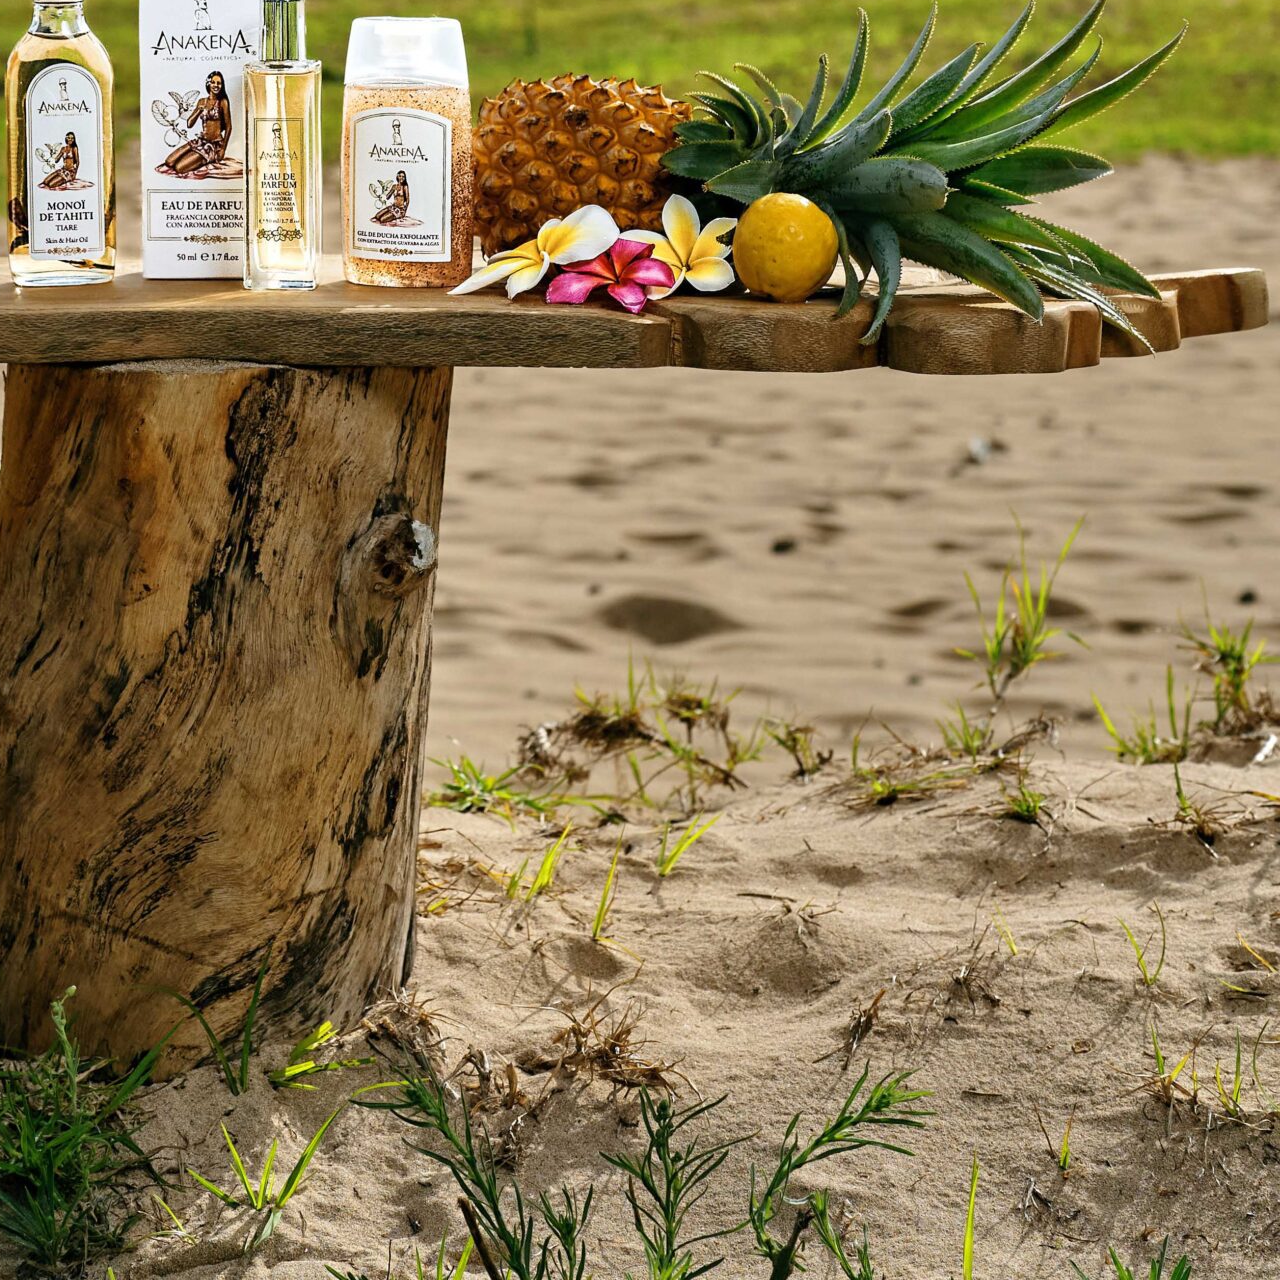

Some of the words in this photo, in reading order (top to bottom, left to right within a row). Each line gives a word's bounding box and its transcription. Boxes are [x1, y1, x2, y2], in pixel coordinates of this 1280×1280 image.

[151, 29, 253, 55] ANAKENA
[37, 100, 89, 114] ANAKENA
[368, 144, 426, 160] ANAKENA
[47, 200, 86, 210] MONOÏ
[162, 201, 184, 210] EAU
[187, 201, 203, 210] DE
[205, 201, 243, 210] PARFU
[40, 212, 54, 222] DE
[56, 212, 94, 221] TAHITI
